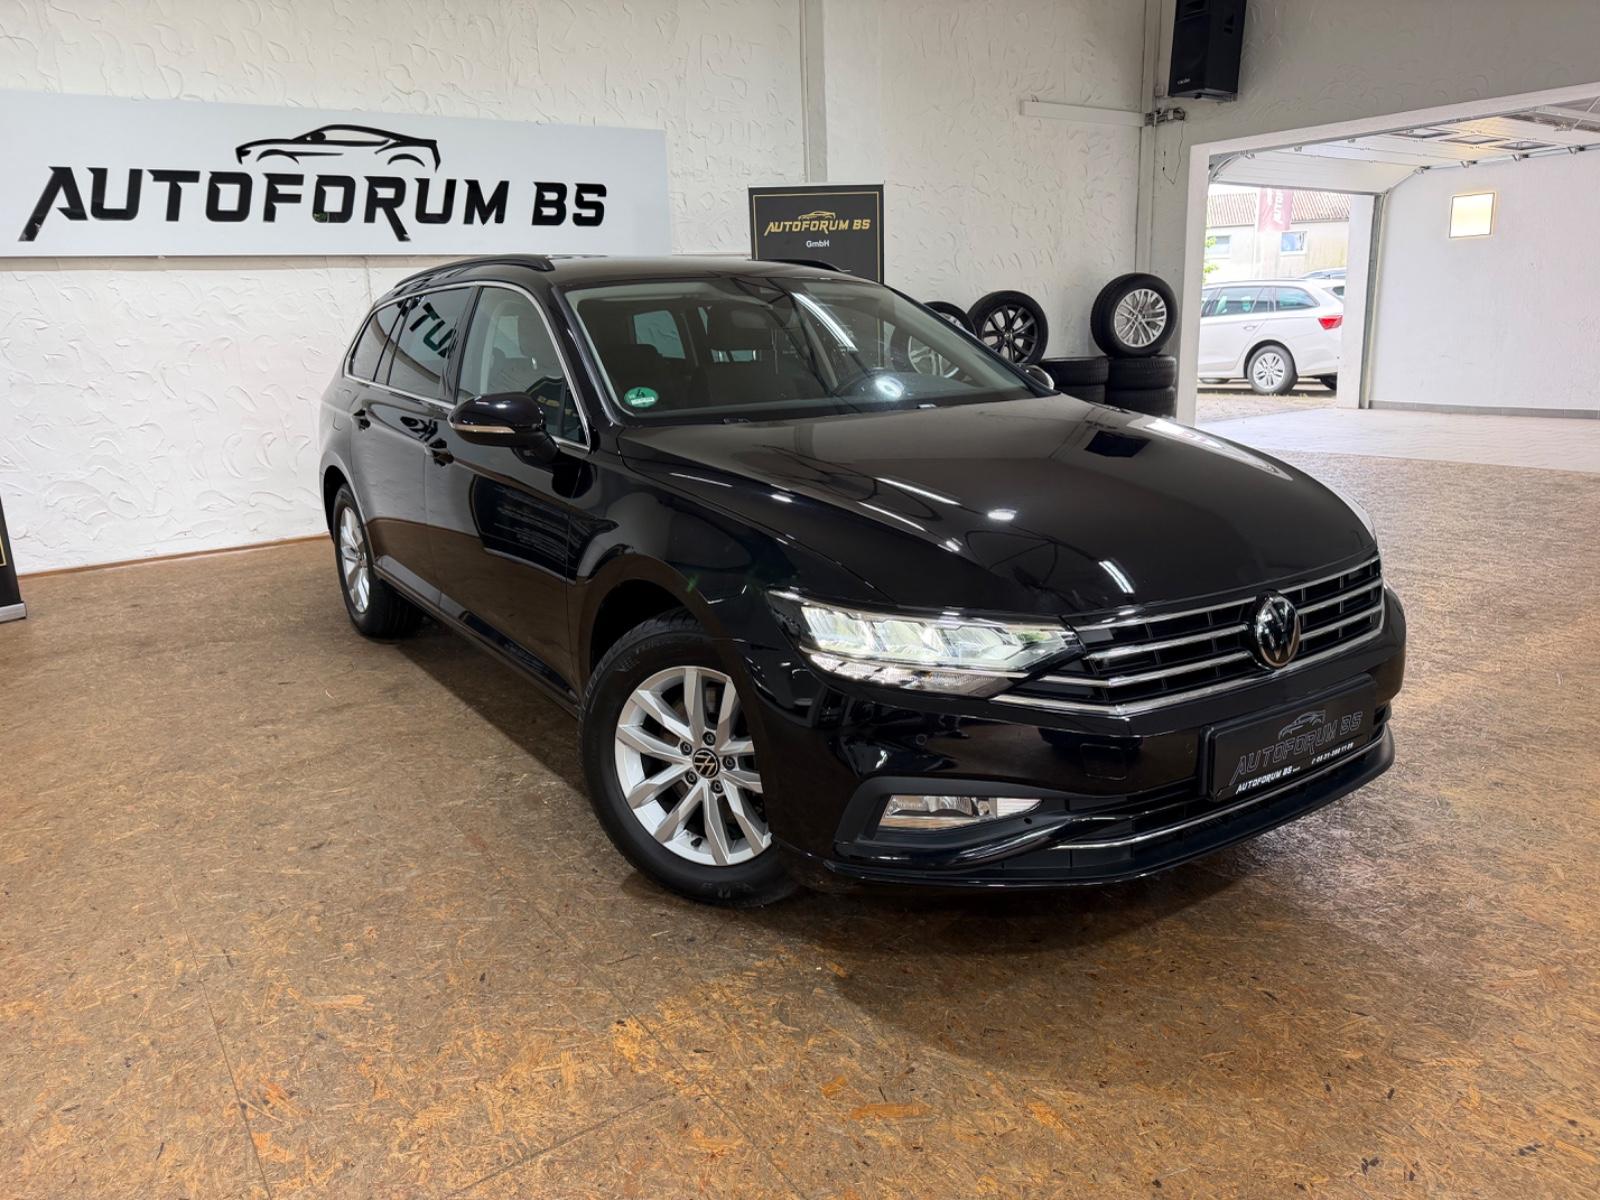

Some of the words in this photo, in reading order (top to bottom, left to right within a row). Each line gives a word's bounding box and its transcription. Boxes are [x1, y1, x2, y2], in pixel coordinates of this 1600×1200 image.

[18, 166, 510, 242] AUTOFORUM
[532, 182, 608, 226] BS
[763, 220, 849, 237] AUTOFORUM
[852, 218, 872, 231] BS
[805, 239, 830, 248] GmbH
[1229, 718, 1338, 786] AUTOFORUM
